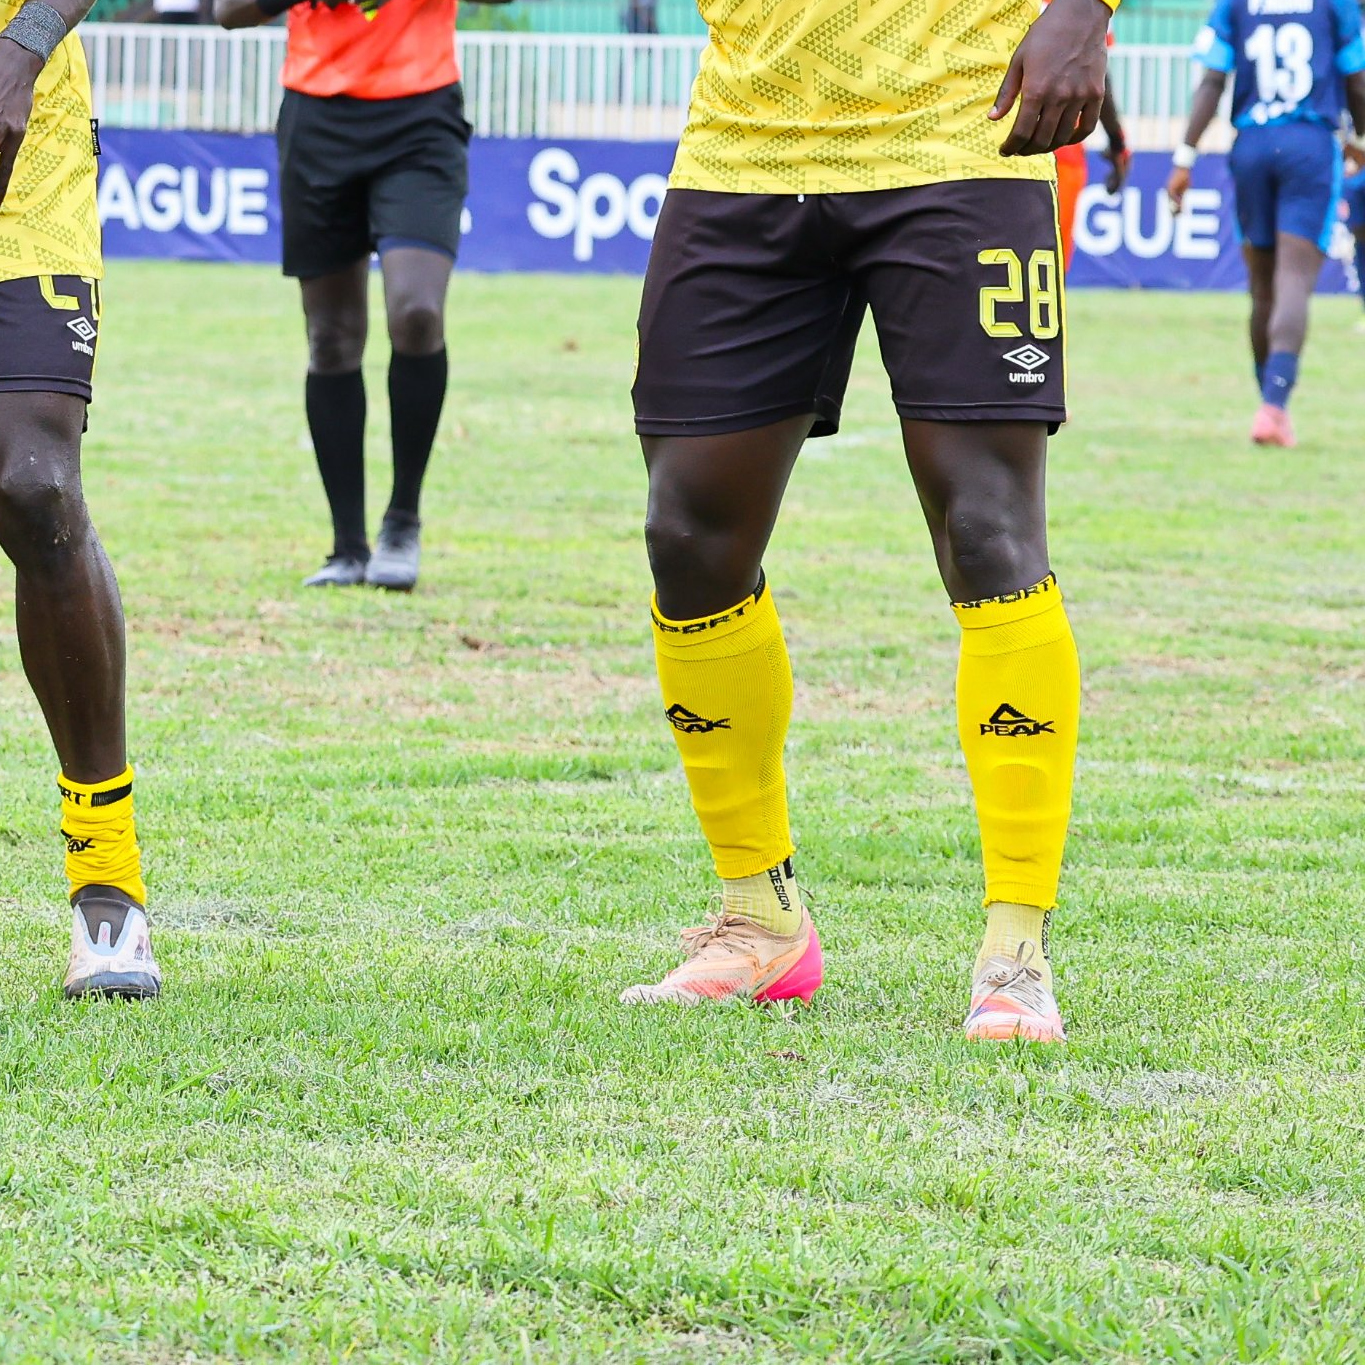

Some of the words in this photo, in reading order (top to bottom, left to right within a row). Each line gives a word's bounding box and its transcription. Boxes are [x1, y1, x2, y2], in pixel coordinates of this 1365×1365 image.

[1244, 21, 1315, 104] 13
[97, 162, 270, 235] AGUE
[1071, 183, 1222, 260] GUE
[977, 248, 1060, 340] 28
[1008, 371, 1046, 383] umbro
[979, 720, 1057, 737] PEAK
